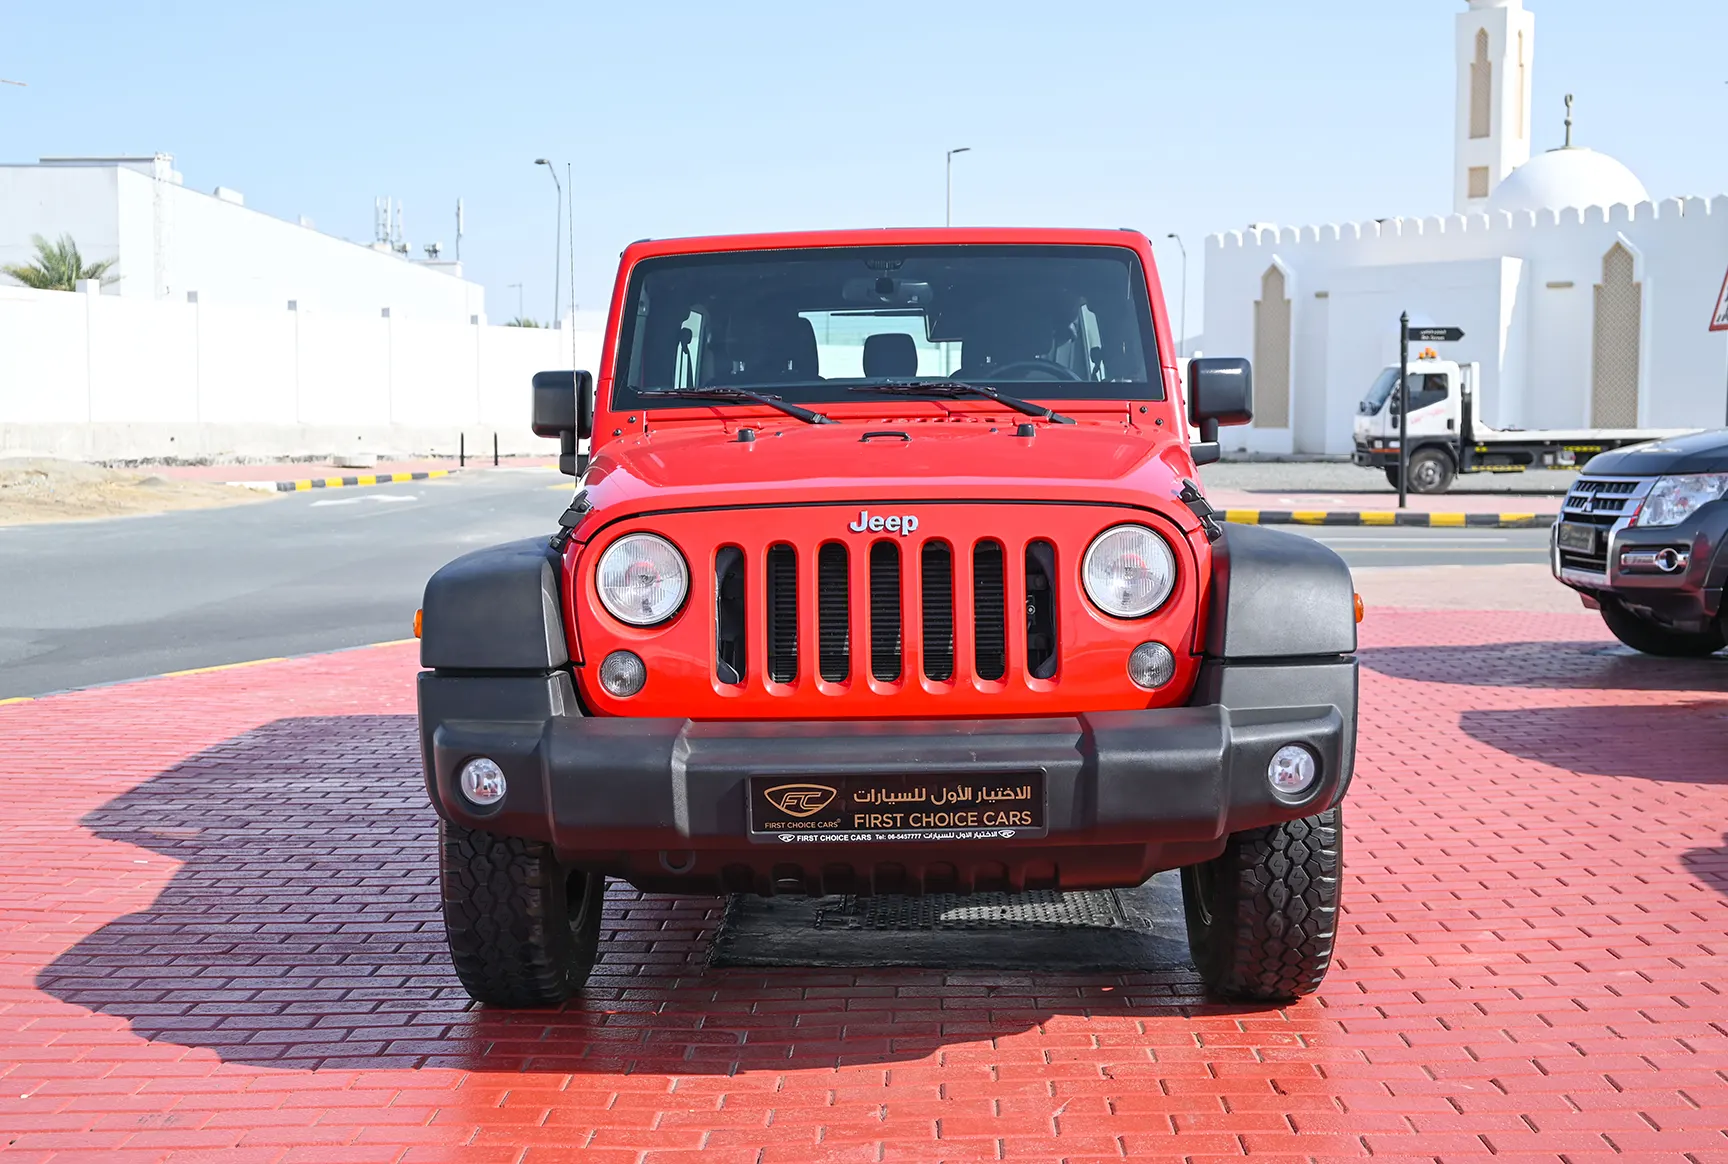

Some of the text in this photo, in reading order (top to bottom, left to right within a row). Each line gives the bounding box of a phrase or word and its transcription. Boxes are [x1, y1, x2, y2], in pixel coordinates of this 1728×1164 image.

[849, 510, 919, 536] Jeep
[853, 785, 1031, 806] الاختيار الأول للسيارات
[787, 821, 816, 829] CHOICE
[854, 810, 1032, 828] FIRST CHOICE CARS
[819, 834, 849, 842] CHOICE
